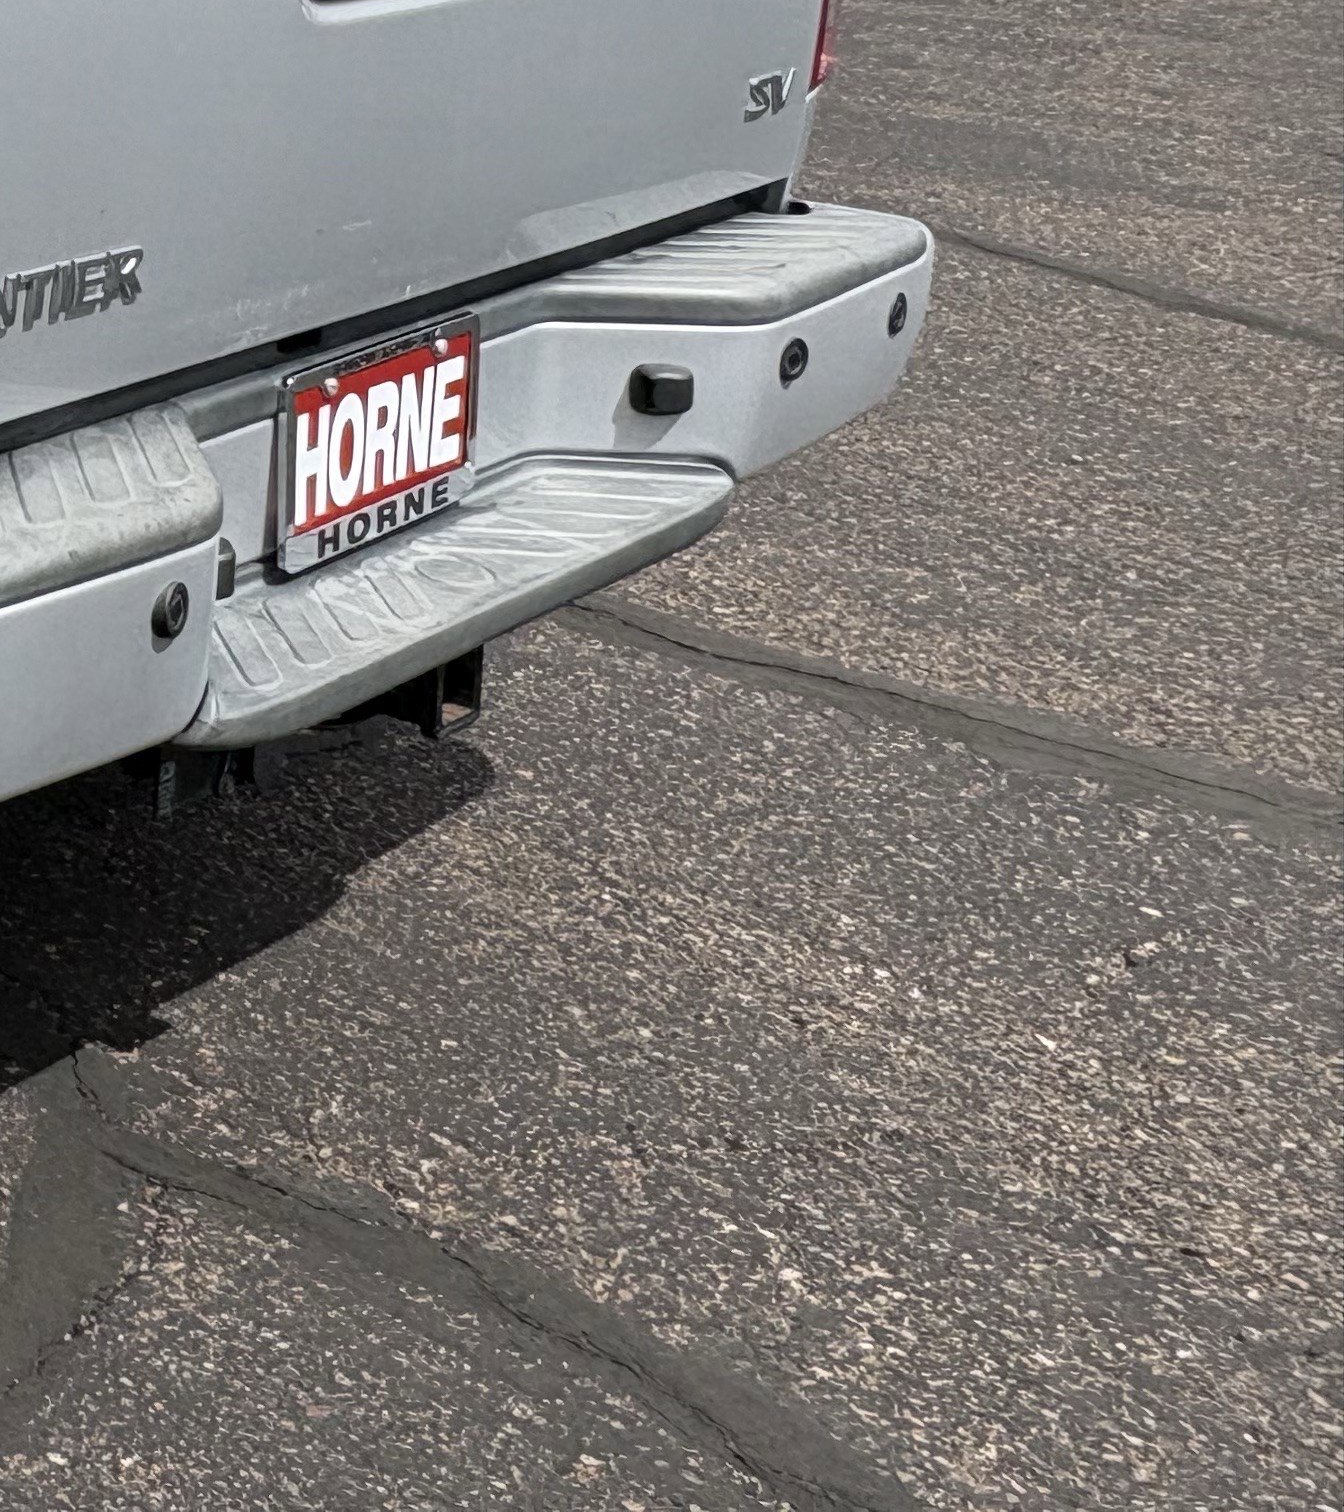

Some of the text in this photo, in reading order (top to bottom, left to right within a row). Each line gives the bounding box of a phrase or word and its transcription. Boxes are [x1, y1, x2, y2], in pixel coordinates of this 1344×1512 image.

[743, 67, 796, 123] SV
[294, 355, 466, 527] HORNE
[317, 475, 450, 559] HORNE
